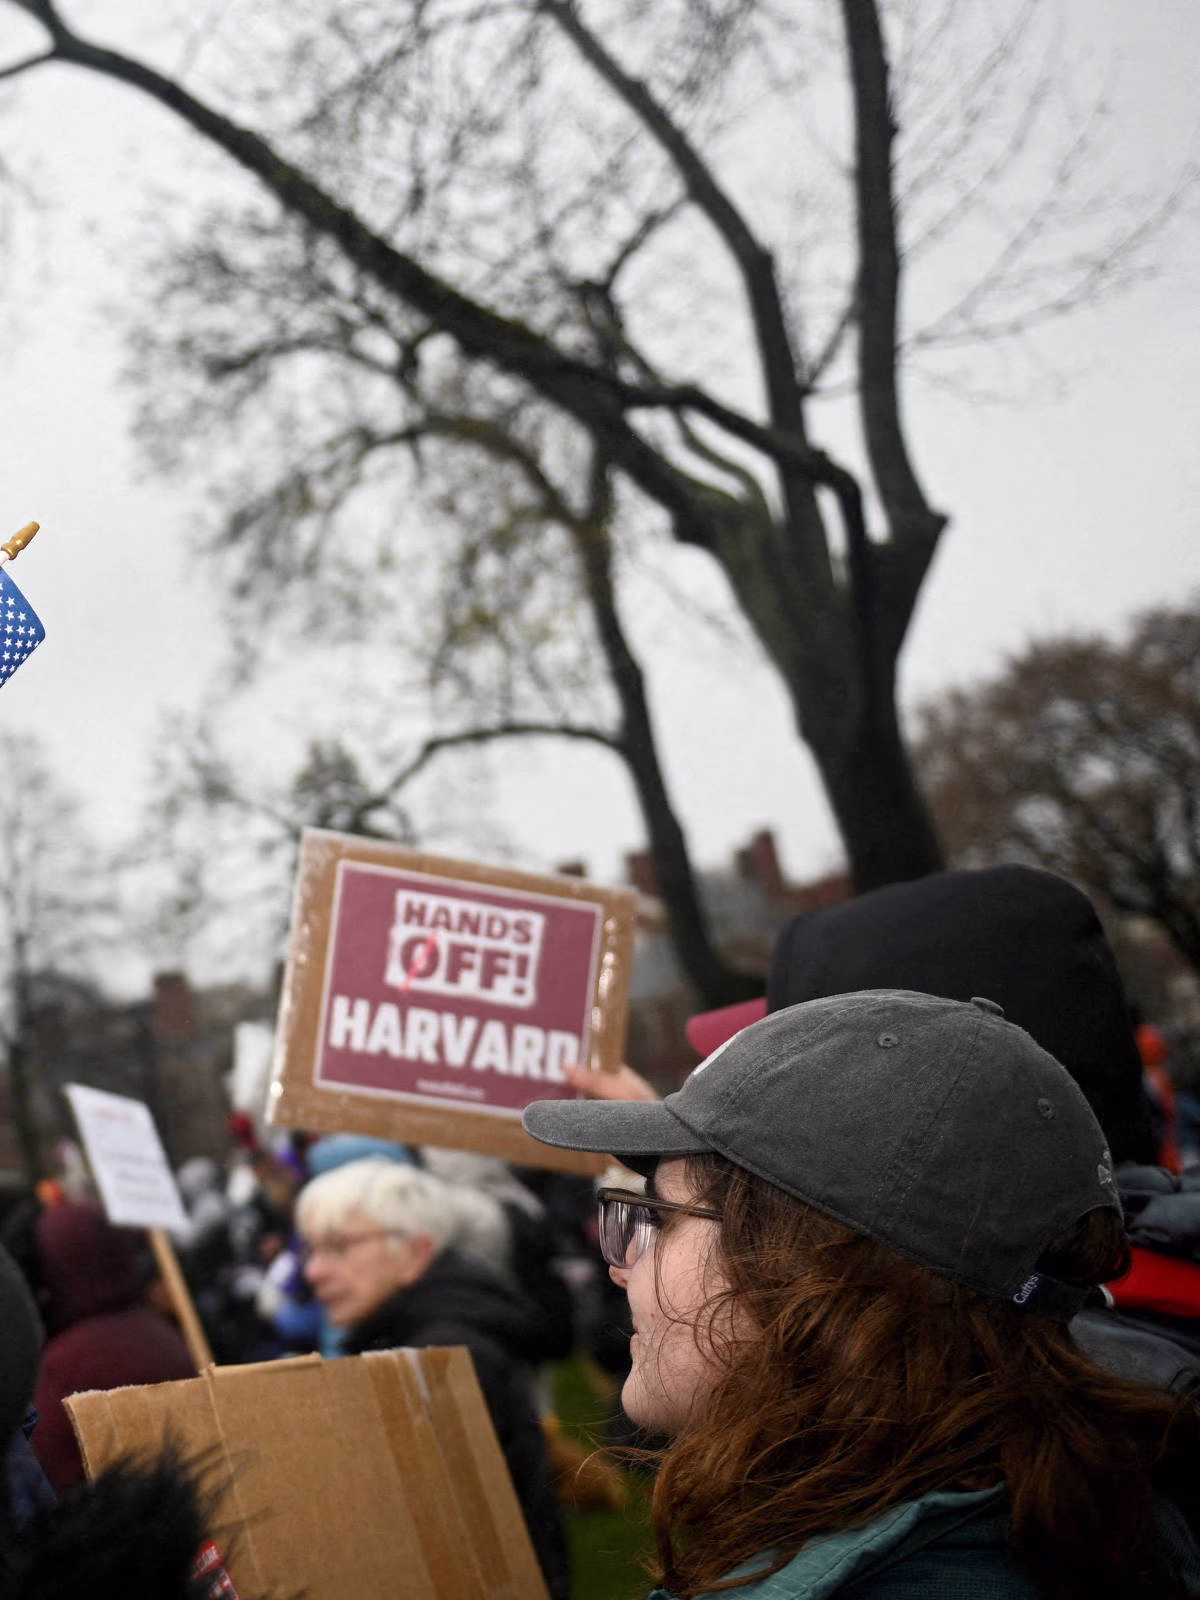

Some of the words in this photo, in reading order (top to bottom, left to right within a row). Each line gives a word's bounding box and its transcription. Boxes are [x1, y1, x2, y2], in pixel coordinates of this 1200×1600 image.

[403, 899, 533, 944] HANDS
[401, 936, 529, 996] OFF!
[331, 995, 579, 1082] HARVARD
